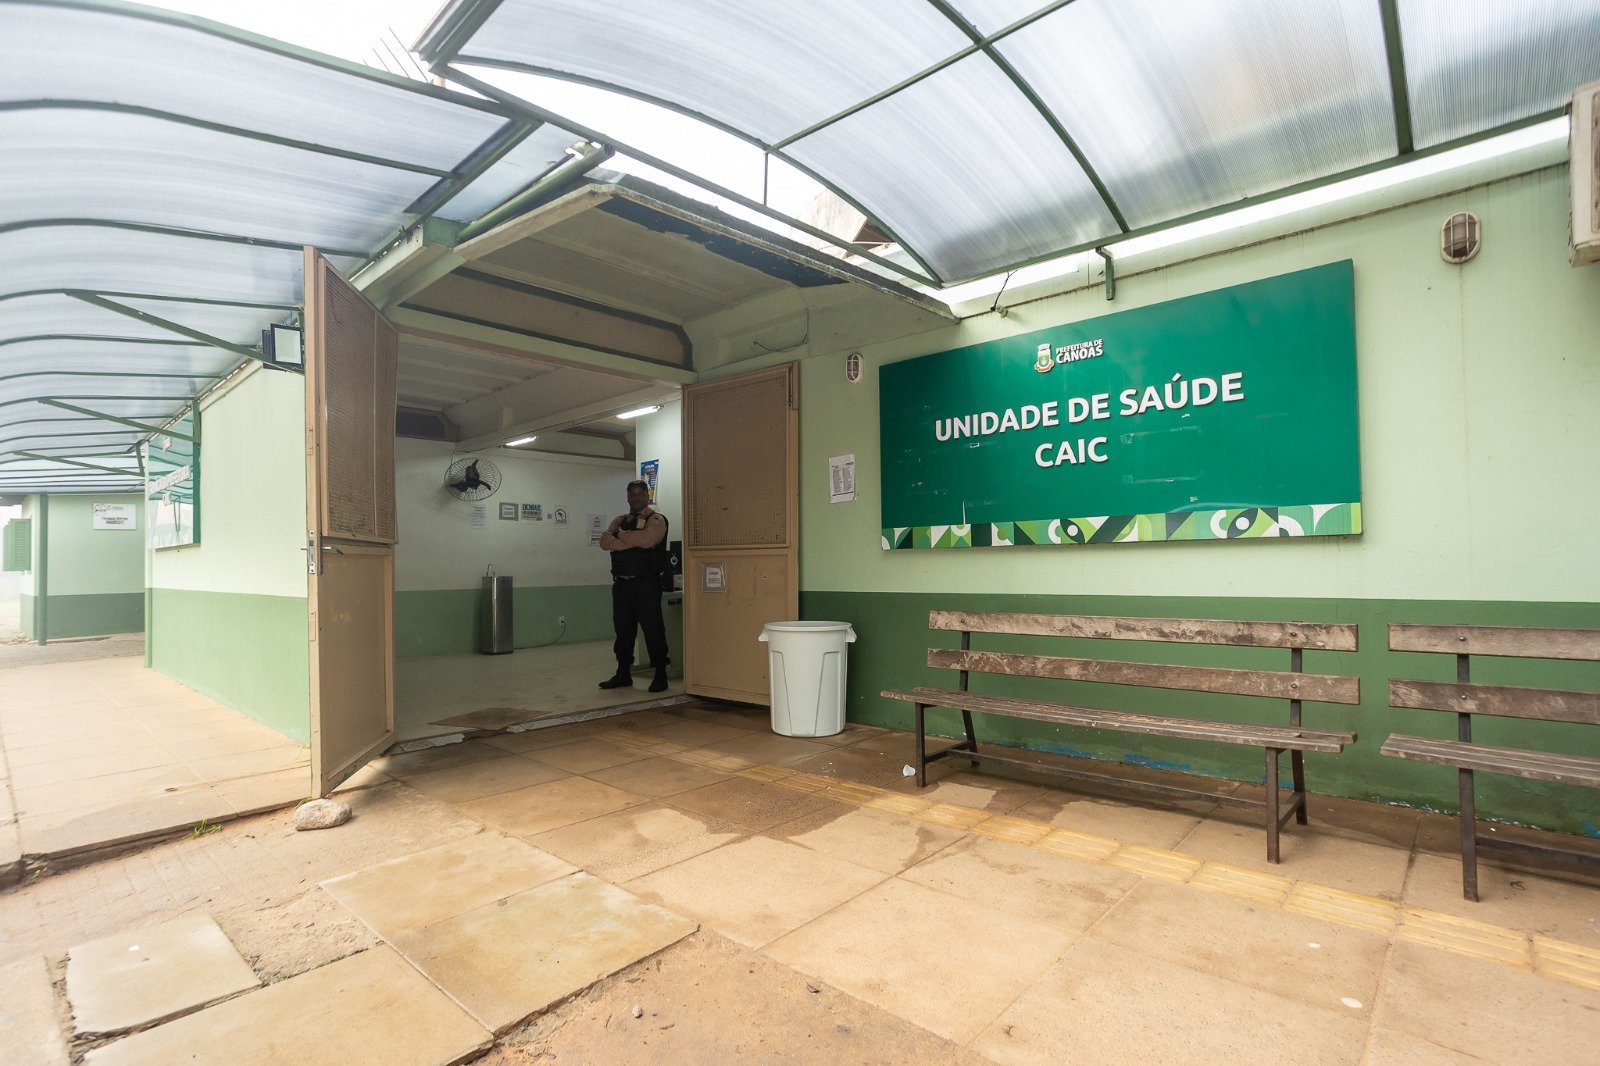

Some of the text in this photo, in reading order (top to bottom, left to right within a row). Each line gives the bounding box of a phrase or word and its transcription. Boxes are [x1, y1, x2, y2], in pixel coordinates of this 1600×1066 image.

[1055, 345, 1103, 364] CANOAS
[1056, 338, 1103, 354] PREFEITURA DE
[935, 371, 1245, 441] UNIDADE DE SAÚDE
[1035, 436, 1108, 468] CAIC
[522, 503, 542, 511] DENGUE
